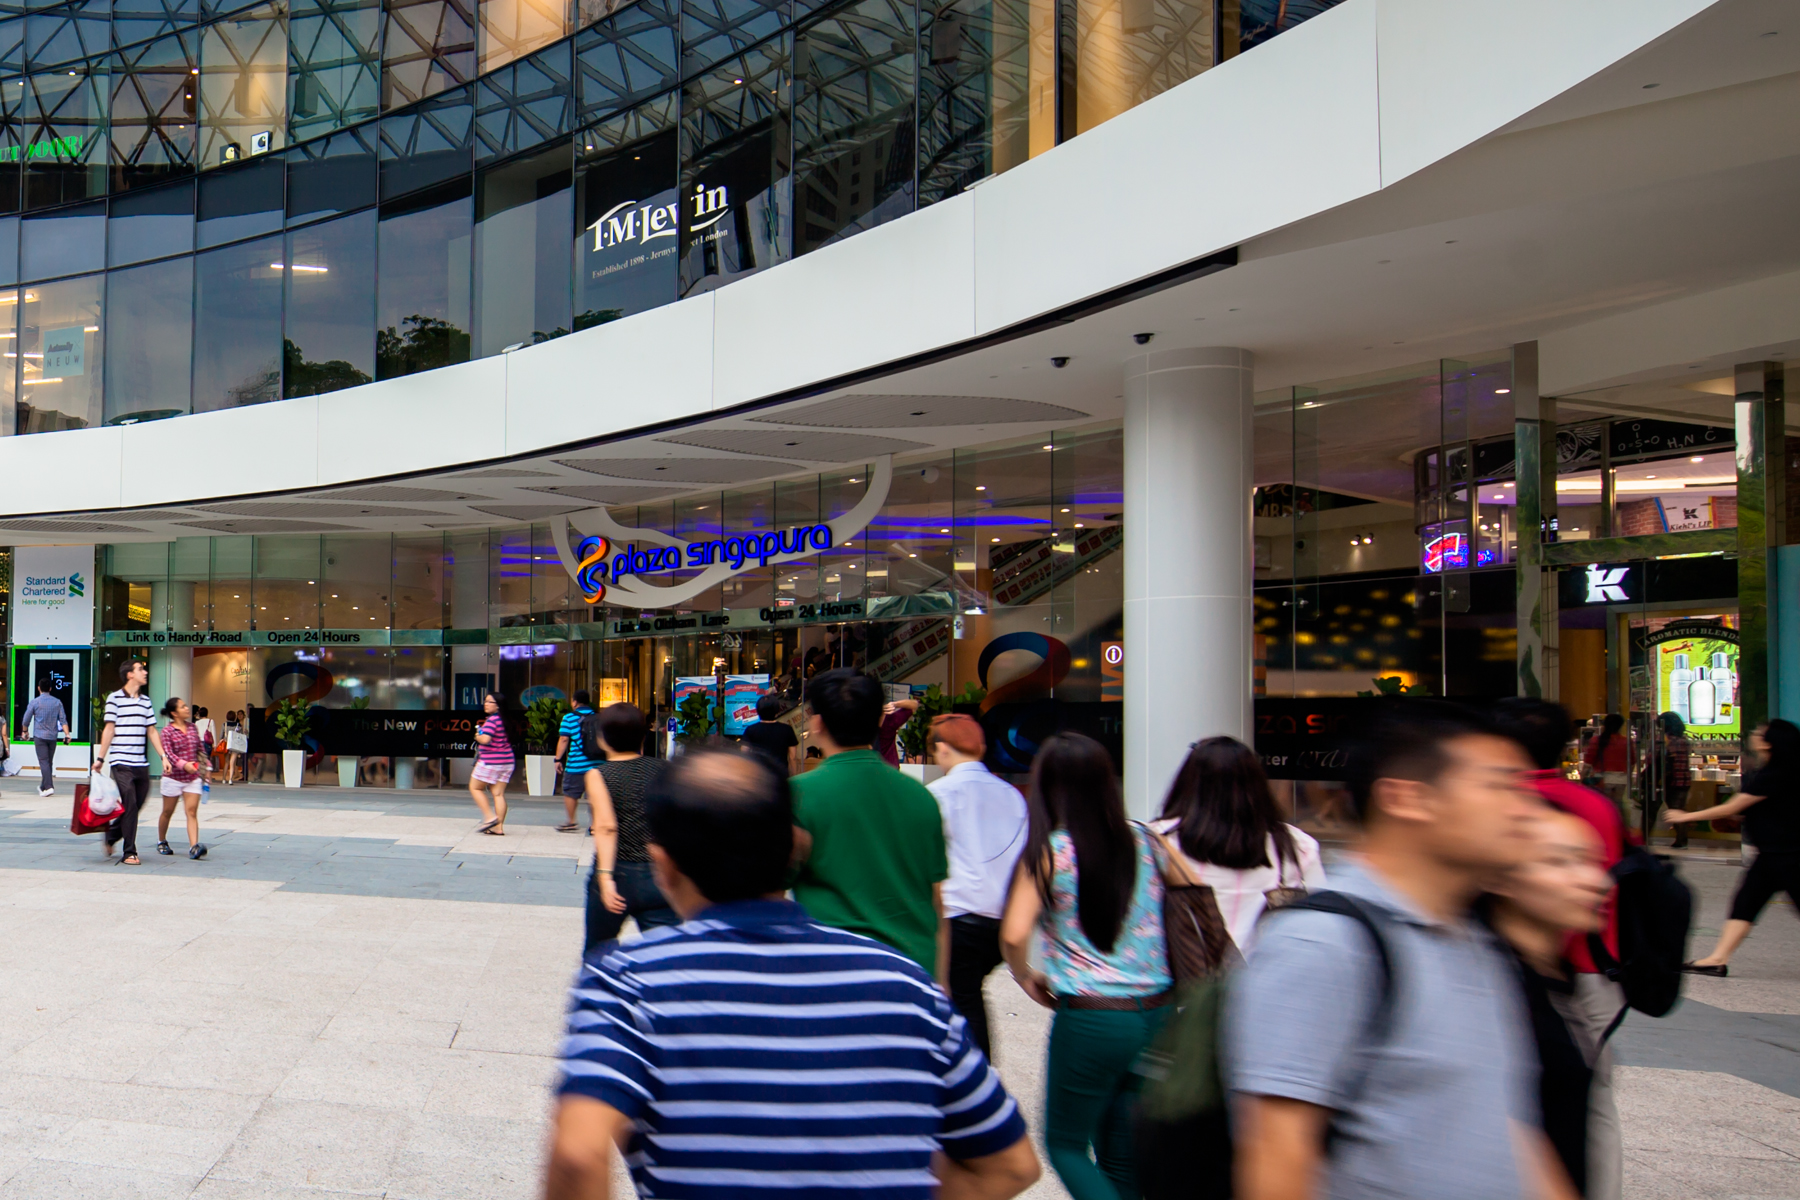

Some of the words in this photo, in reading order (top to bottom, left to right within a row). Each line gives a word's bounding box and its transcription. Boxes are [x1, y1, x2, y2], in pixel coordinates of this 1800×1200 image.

[592, 261, 628, 279] Established
[630, 255, 645, 267] 1898
[650, 246, 677, 260] Jermyn
[700, 229, 728, 244] London
[1670, 522, 1696, 531] Kiehl's
[612, 544, 682, 584] plaza
[686, 524, 832, 570] singapura
[26, 576, 66, 586] Standard
[22, 587, 66, 596] Chartered
[48, 599, 65, 607] good
[614, 621, 635, 633] Link
[639, 620, 651, 632] to
[702, 614, 730, 627] Lane
[760, 607, 794, 624] Open
[798, 605, 815, 619] 24
[820, 600, 862, 617] Hours
[126, 631, 150, 642] Link
[153, 633, 165, 642] to
[168, 632, 206, 645] Handy
[210, 632, 242, 642] Road
[268, 632, 300, 645] Open
[304, 632, 319, 642] 24
[322, 631, 361, 642] Hours
[1644, 628, 1698, 646] AROMATIC
[49, 670, 54, 681] 1
[55, 679, 63, 690] 3
[352, 718, 379, 731] The
[384, 718, 417, 731] New
[424, 715, 471, 735] plaza
